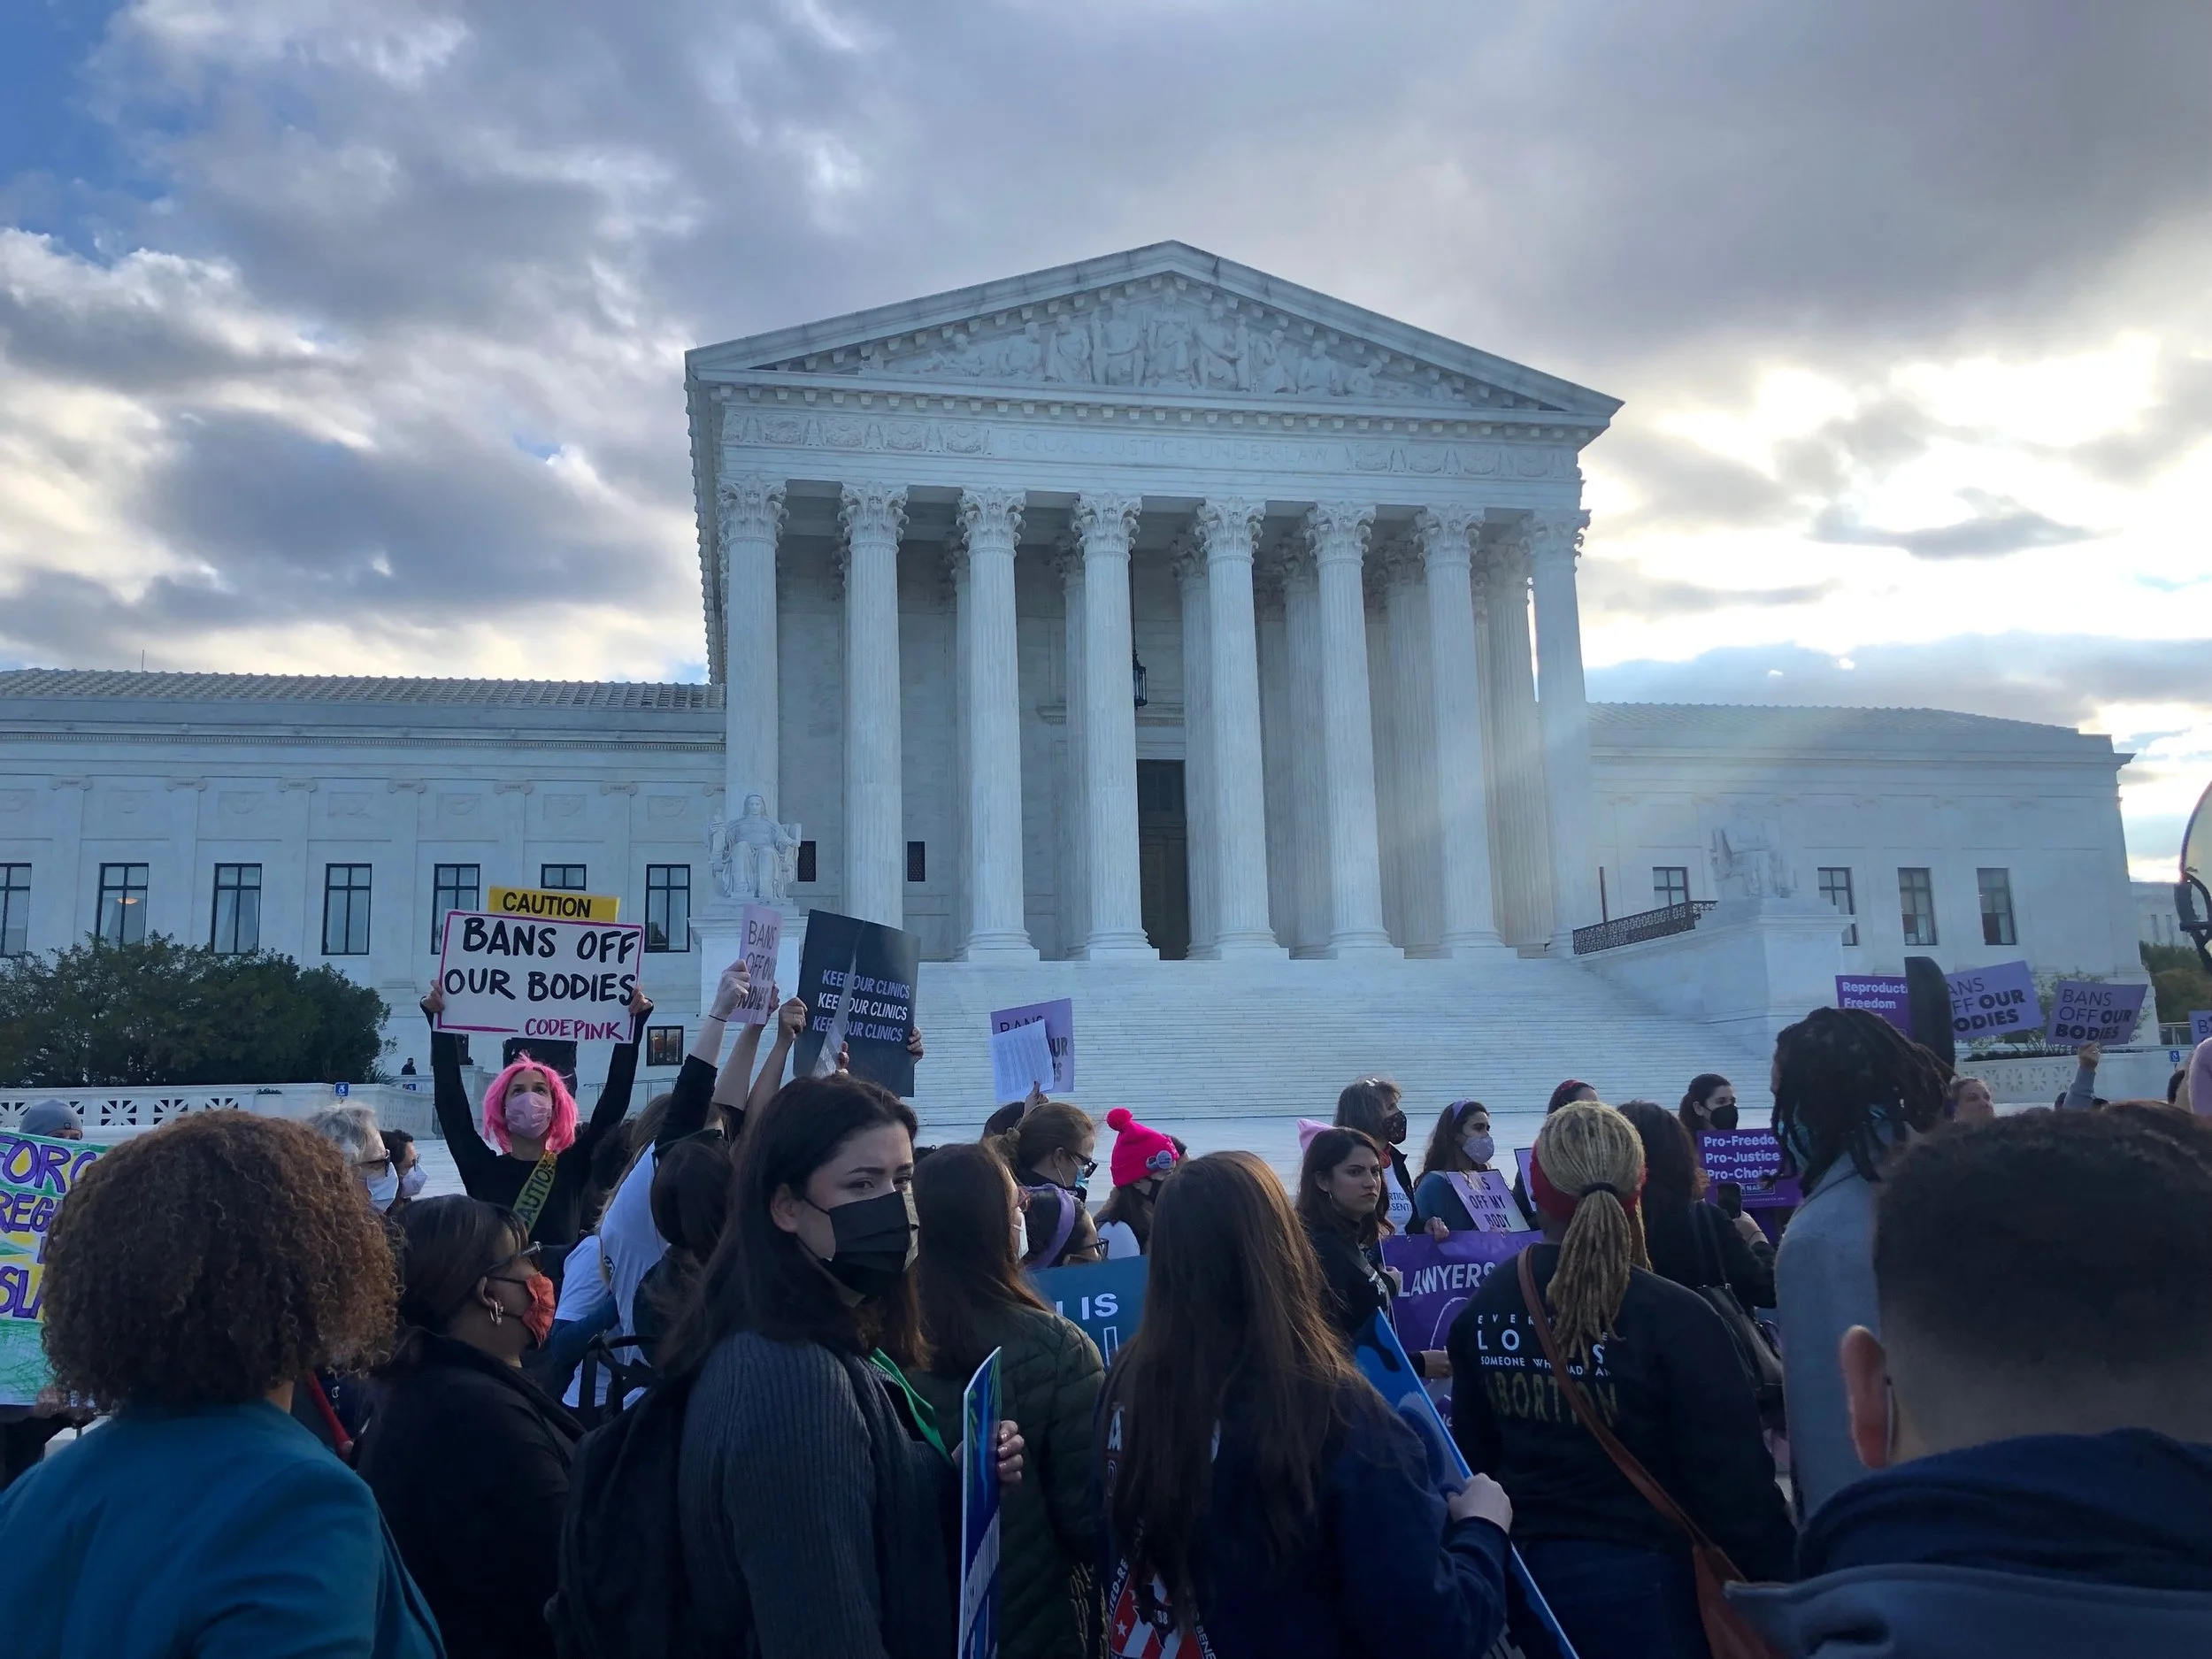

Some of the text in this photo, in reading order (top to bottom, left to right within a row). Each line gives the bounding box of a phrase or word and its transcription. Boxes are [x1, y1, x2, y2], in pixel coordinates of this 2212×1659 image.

[503, 892, 592, 918] CAUTION
[463, 917, 640, 964] BANS OFF
[748, 920, 777, 950] BANS
[746, 952, 765, 978] OFF
[444, 968, 636, 1006] OUR BODIES
[852, 974, 875, 994] OUR
[876, 979, 910, 1000] CLINICS
[1842, 981, 1909, 995] Reproducti
[1947, 977, 1985, 996] ANS
[818, 992, 842, 1010] KEE
[870, 1002, 908, 1021] CLINICS
[1844, 997, 1896, 1010] Freedom
[1952, 988, 2026, 1015] FF OUR
[2062, 988, 2113, 1007] BANS
[1953, 1008, 2019, 1033] ODIES
[2059, 1006, 2132, 1025] OFF OUR
[525, 1018, 624, 1041] CODEPINK
[864, 1023, 904, 1042] CLINICS
[2055, 1023, 2121, 1041] BODIES
[1050, 1036, 1069, 1057] UR
[1703, 1133, 1778, 1148] Pro-Freedo
[1705, 1150, 1781, 1164] Pro-Justice
[1469, 1194, 1507, 1210] OFF MY
[1484, 1213, 1512, 1228] BODY
[1081, 1293, 1119, 1321] IS
[1480, 1356, 1526, 1367] SOMEONE
[1532, 1358, 1554, 1370] WH
